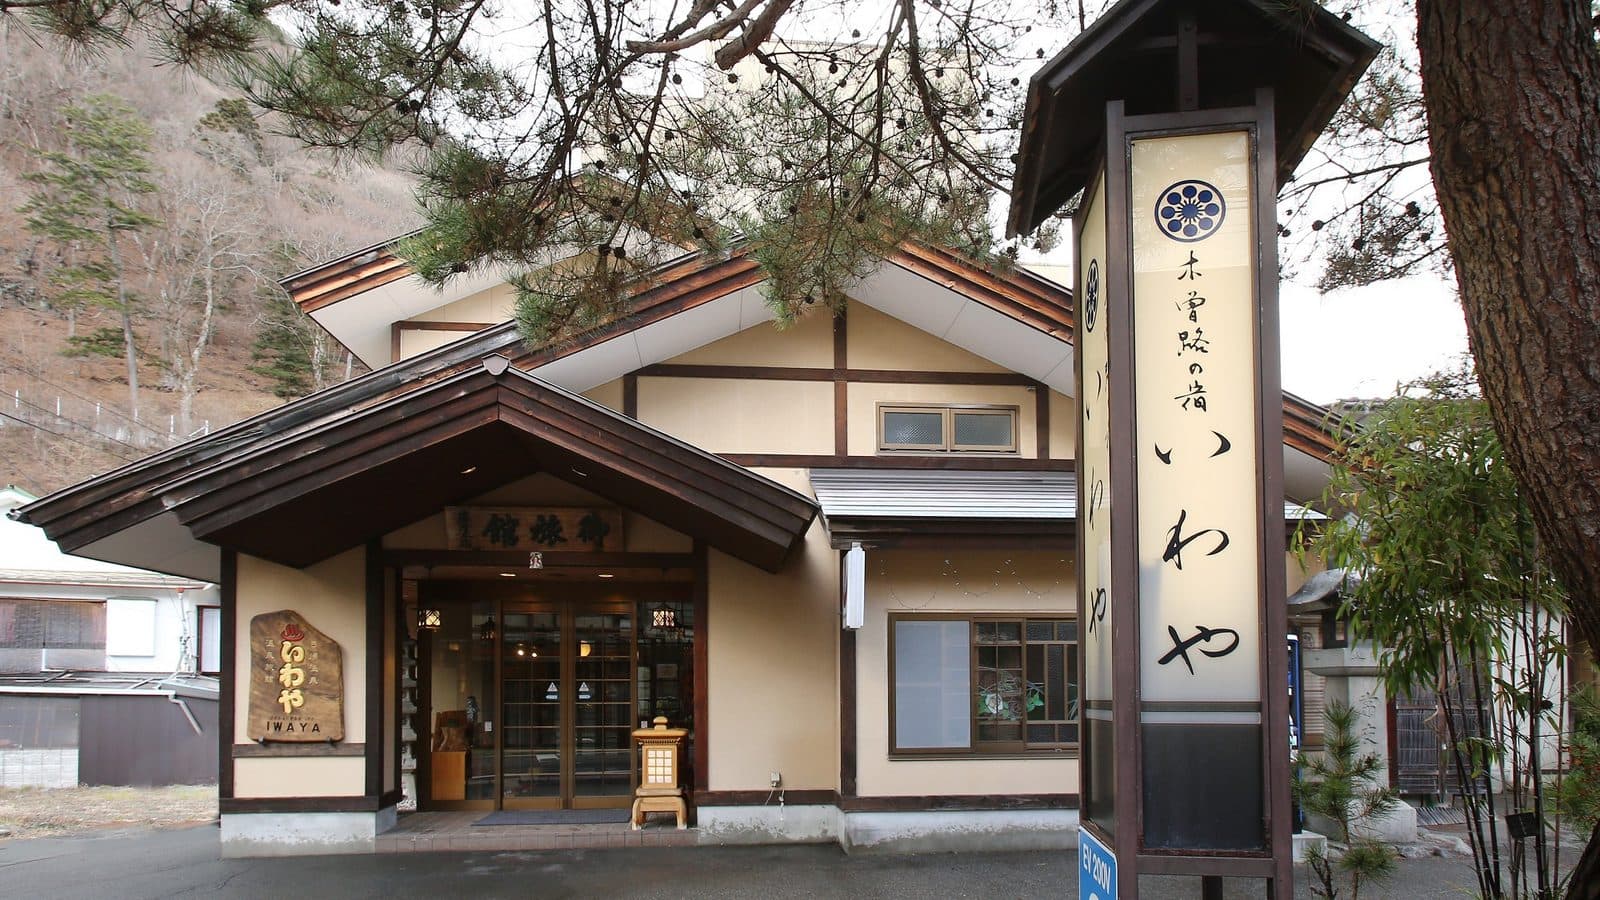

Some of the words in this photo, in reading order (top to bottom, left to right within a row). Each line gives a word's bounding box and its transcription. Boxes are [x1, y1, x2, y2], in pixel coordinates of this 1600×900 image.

[1154, 429, 1240, 676] いわや
[278, 640, 306, 715] いわや
[266, 720, 321, 734] IWAYA
[1082, 843, 1092, 875] EV
[1092, 852, 1111, 896] 200V
